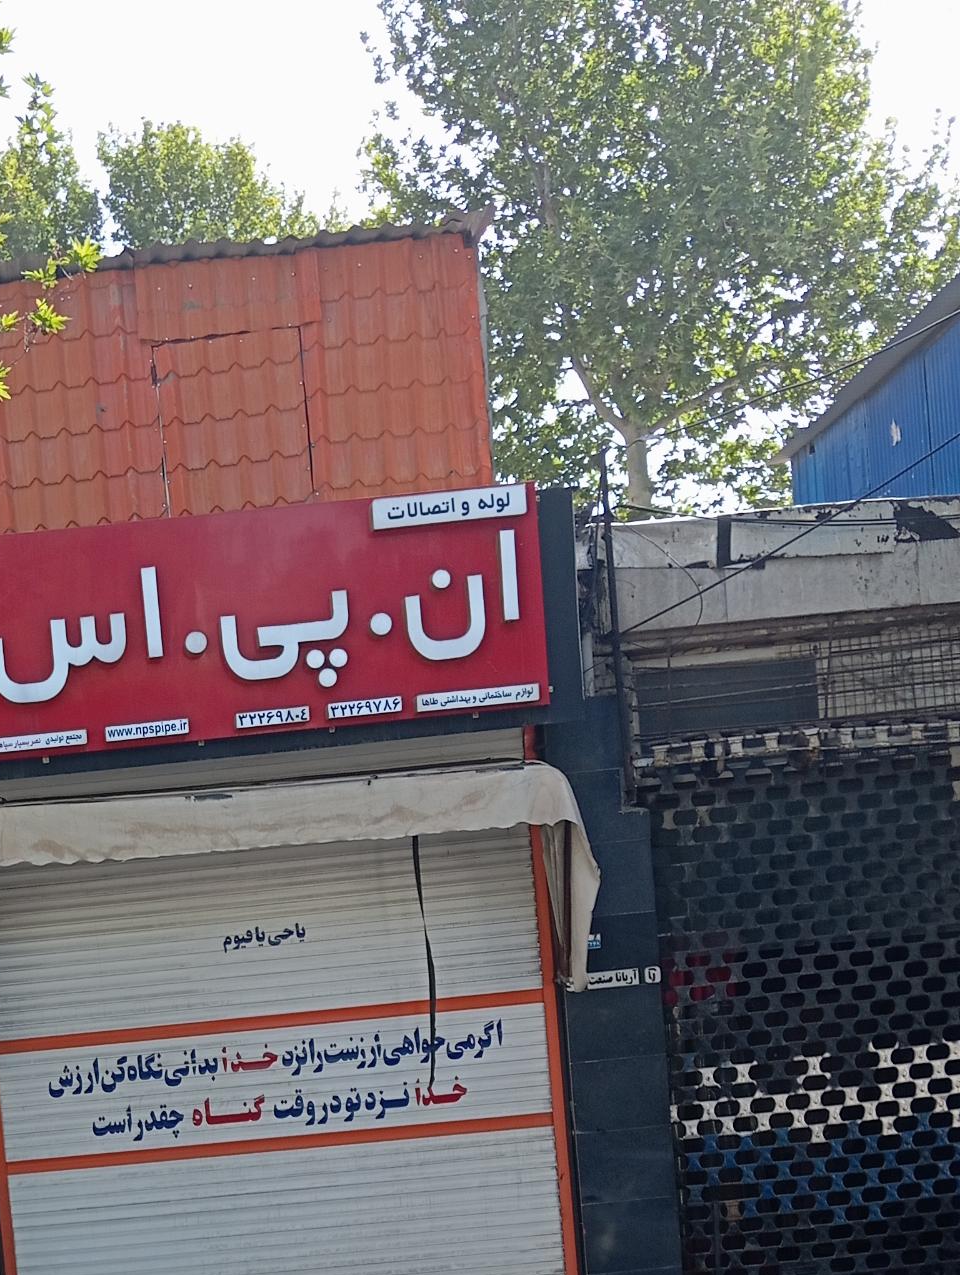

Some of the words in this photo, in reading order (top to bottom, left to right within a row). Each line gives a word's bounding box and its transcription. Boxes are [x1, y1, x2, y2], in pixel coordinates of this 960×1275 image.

[387, 497, 456, 520] اتصالات
[461, 500, 470, 516] و
[477, 491, 511, 513] لوله
[330, 697, 401, 717] ۳۲۲۶۹۷۸۶
[107, 720, 188, 739] www.npspipe.ir
[192, 1094, 266, 1127] گناه
